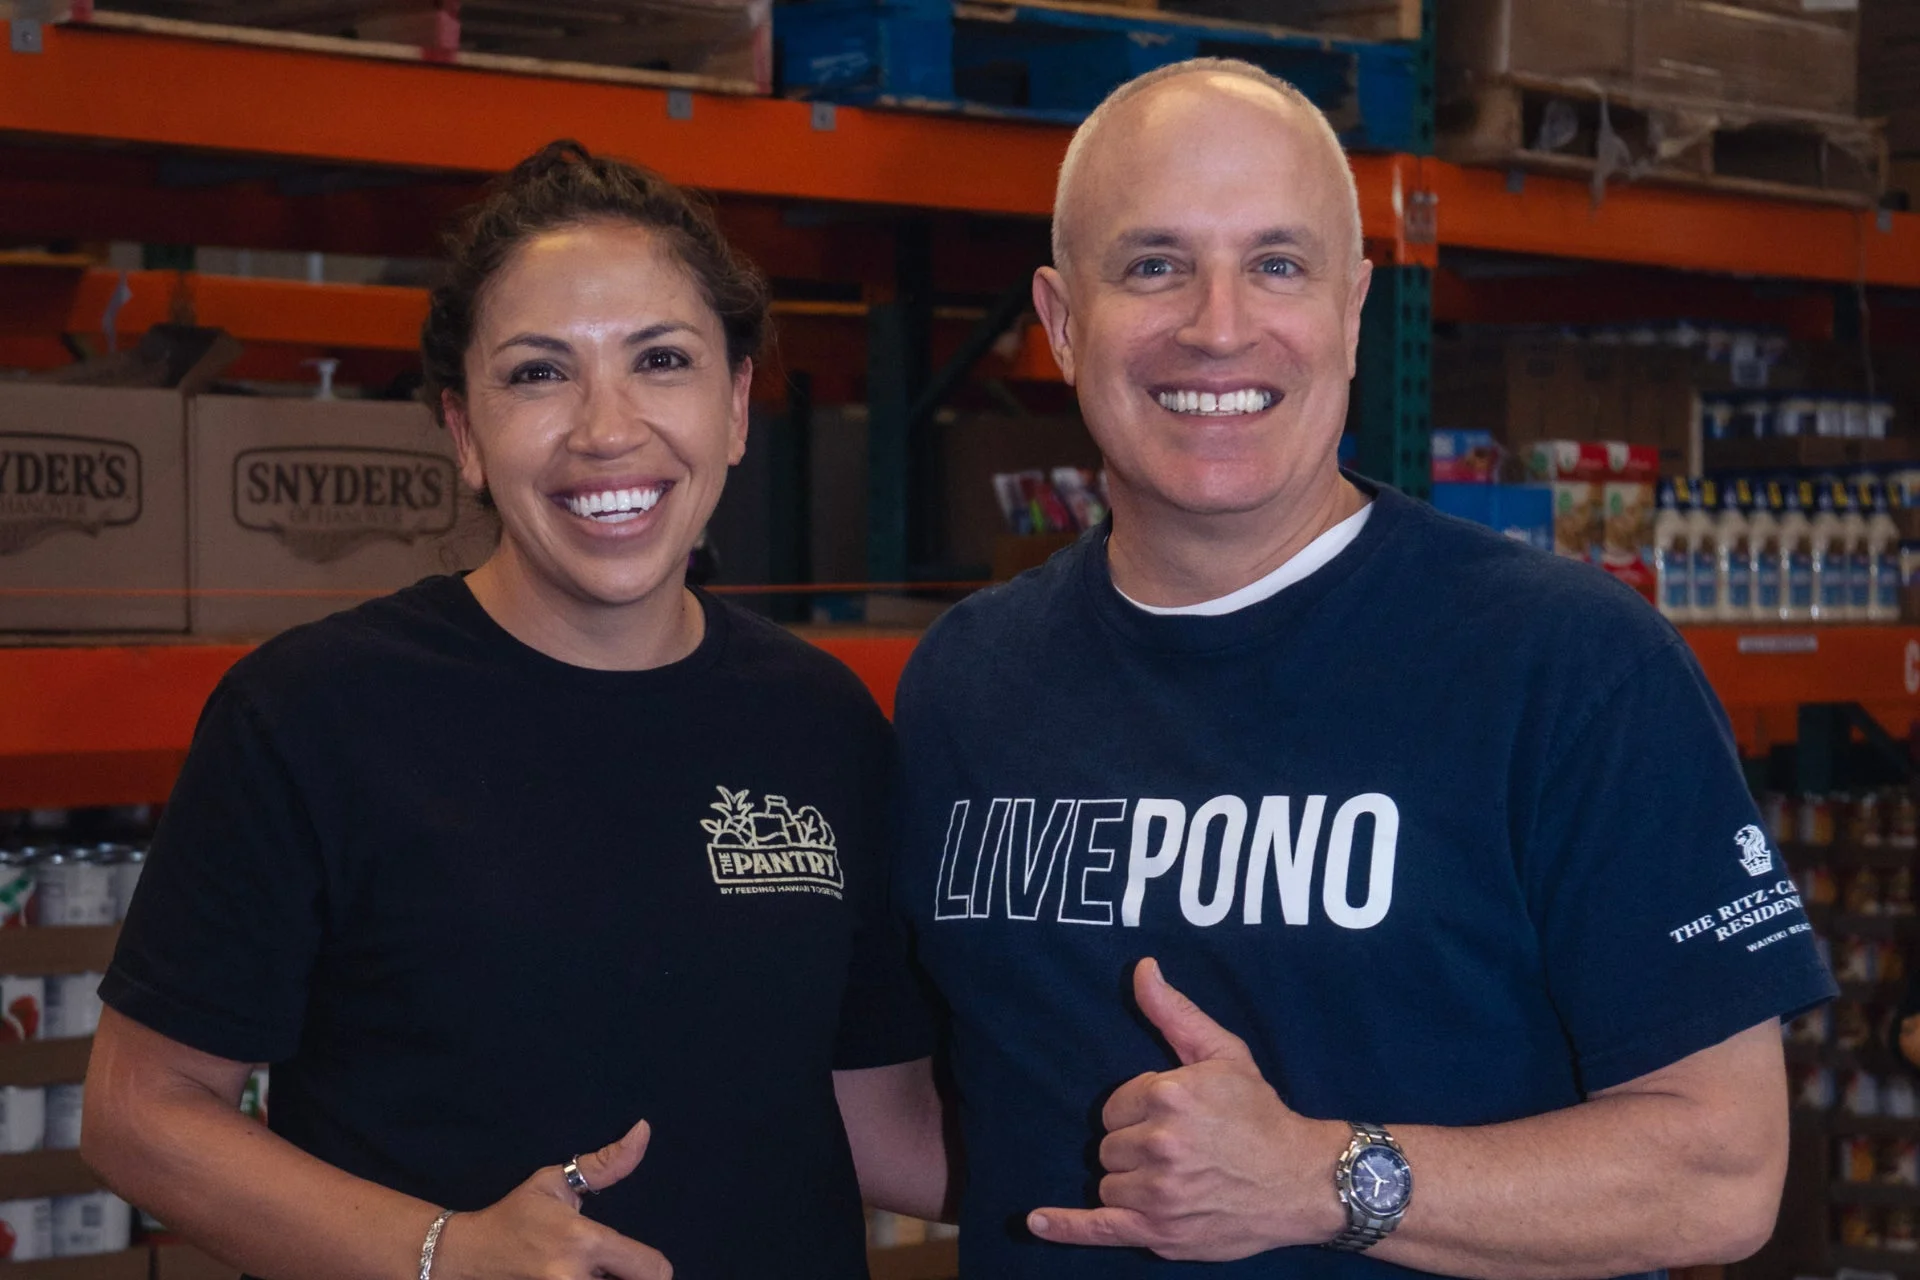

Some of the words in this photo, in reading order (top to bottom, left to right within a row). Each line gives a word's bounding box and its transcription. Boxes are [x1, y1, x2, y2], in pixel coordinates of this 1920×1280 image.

[247, 460, 443, 510] SNYDER'S
[718, 852, 734, 875] THE
[732, 851, 834, 877] PANTRY
[720, 887, 734, 895] BY
[735, 885, 776, 895] FEEDING
[1669, 914, 1715, 944] THE
[1717, 879, 1798, 921] RITZ-CA
[1714, 894, 1803, 942] RESIDEN
[1746, 930, 1788, 952] WAIKIKI
[1789, 922, 1812, 935] BEAC
